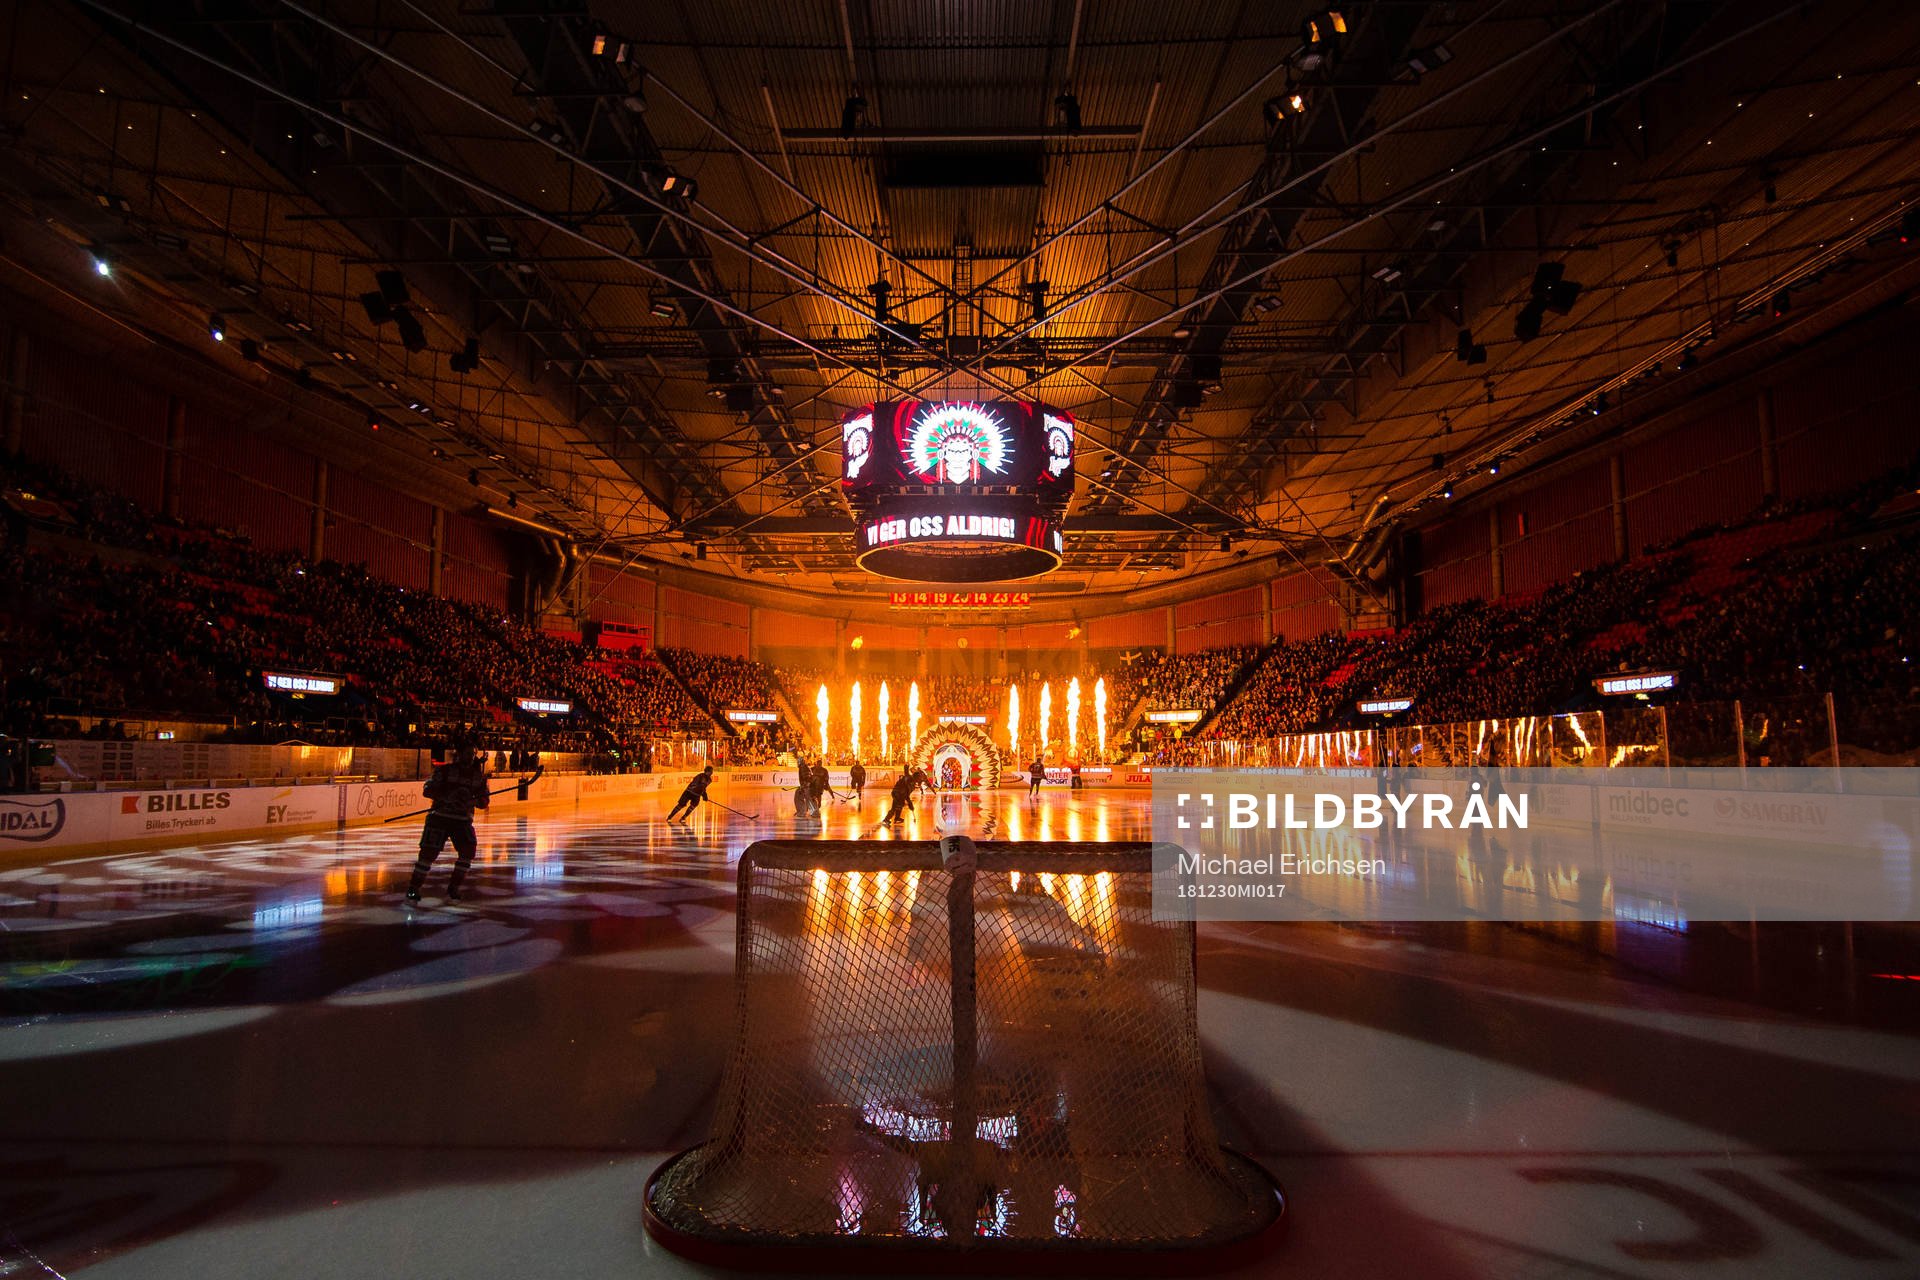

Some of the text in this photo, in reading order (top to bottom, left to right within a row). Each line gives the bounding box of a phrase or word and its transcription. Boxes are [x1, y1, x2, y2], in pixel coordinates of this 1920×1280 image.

[879, 519, 907, 541] GER
[909, 516, 943, 537] OSS
[946, 515, 1015, 538] ALDRIG!
[1126, 775, 1151, 783] JULA
[147, 792, 231, 813] BILLES
[376, 789, 417, 809] offitech
[1608, 790, 1690, 817] midbec
[0, 810, 53, 831] IDAL
[145, 815, 217, 830] Billes Tryckeri ab
[267, 804, 288, 824] EY
